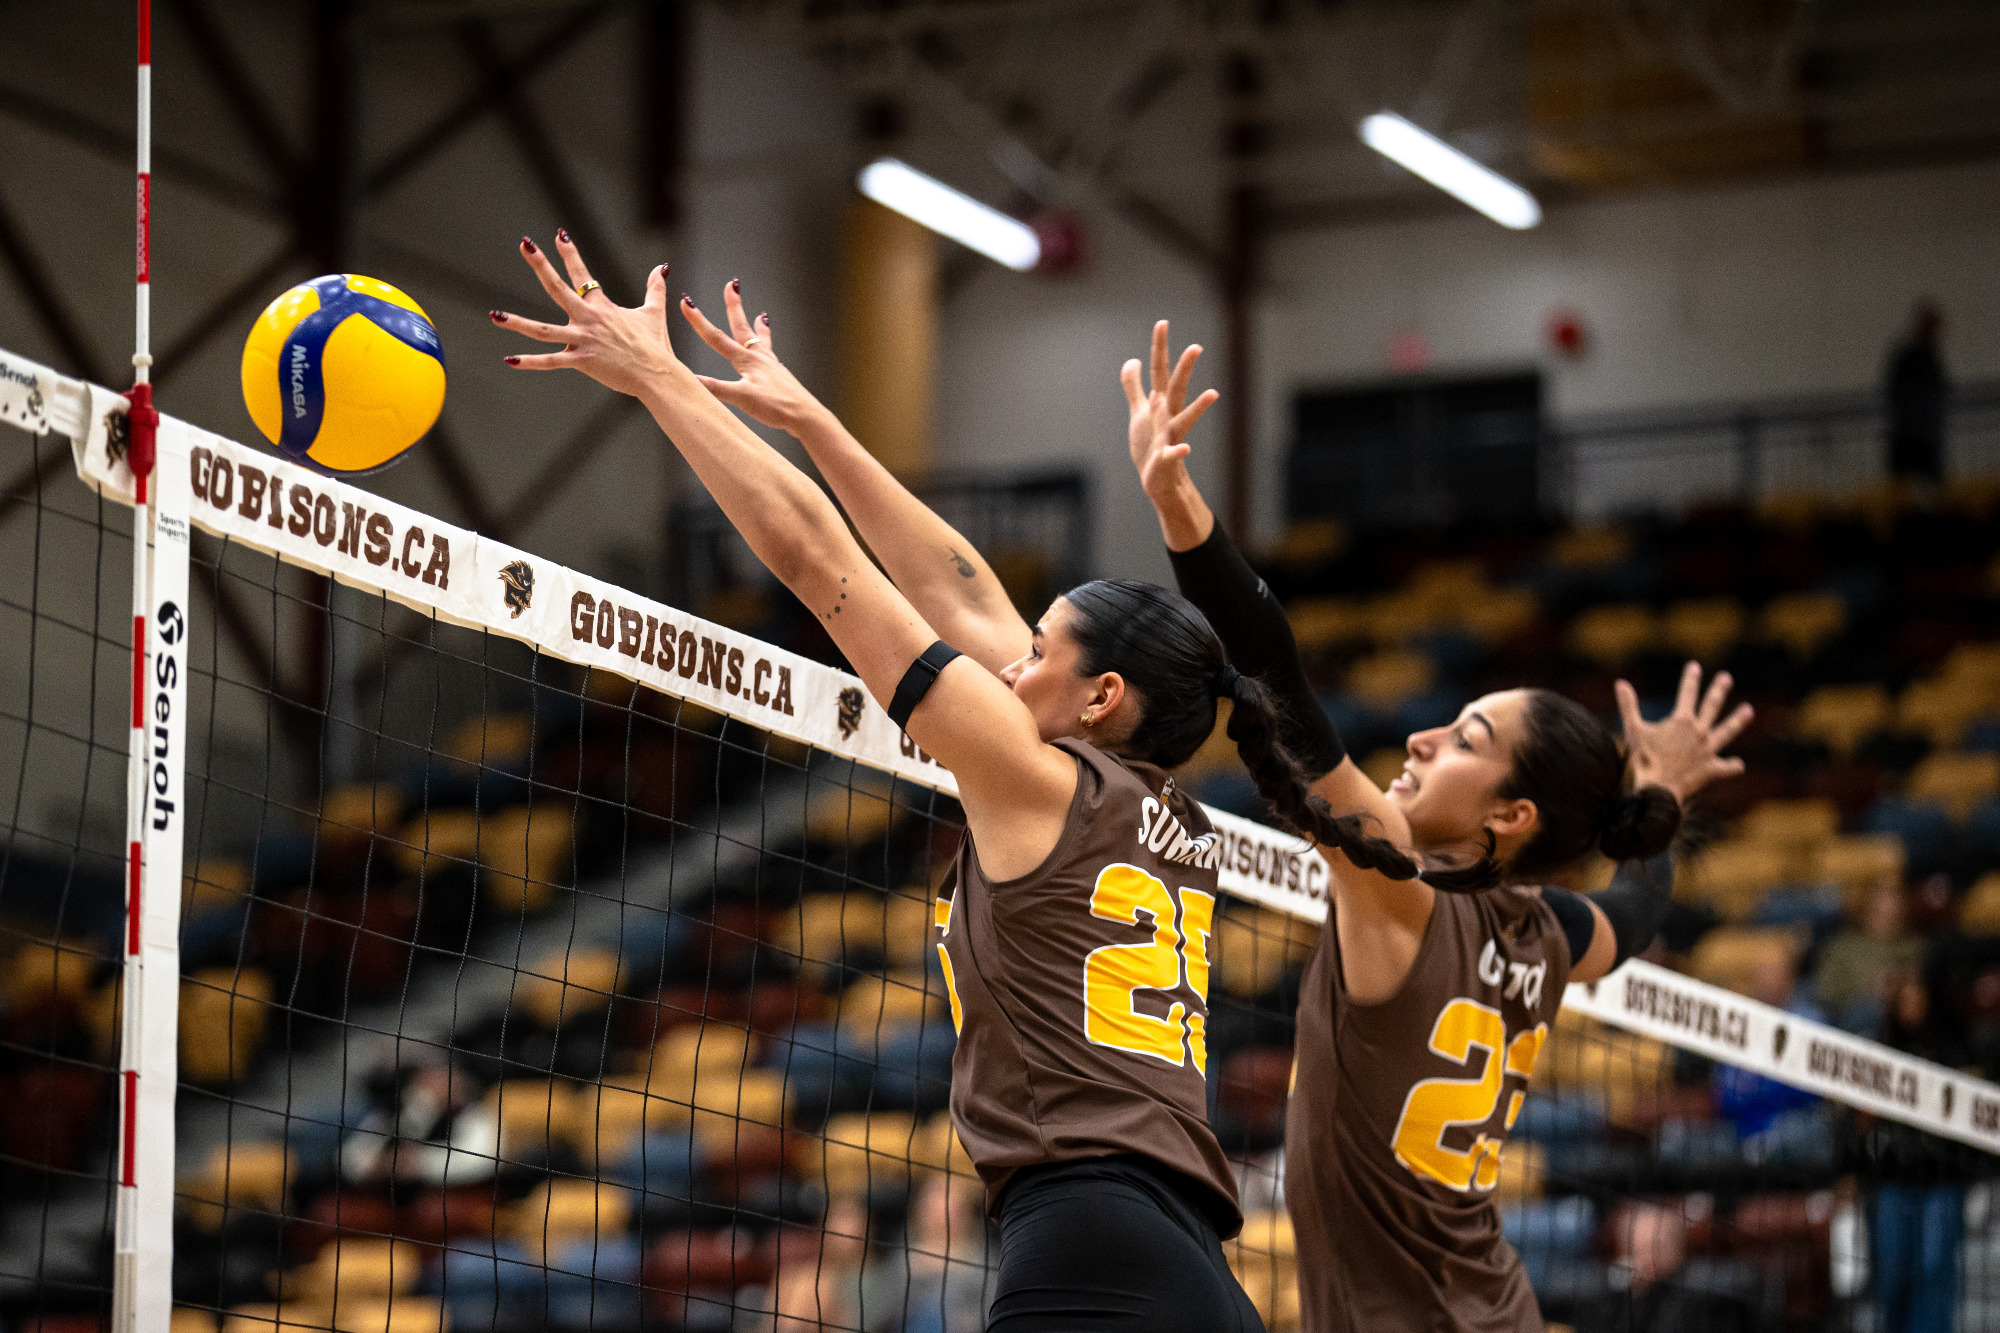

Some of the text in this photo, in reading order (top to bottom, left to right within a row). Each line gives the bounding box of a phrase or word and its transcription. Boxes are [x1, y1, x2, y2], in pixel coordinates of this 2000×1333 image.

[190, 446, 450, 591] GOBISONS.CA
[571, 590, 794, 717] GOBISONS.CA
[152, 652, 178, 833] Senoh
